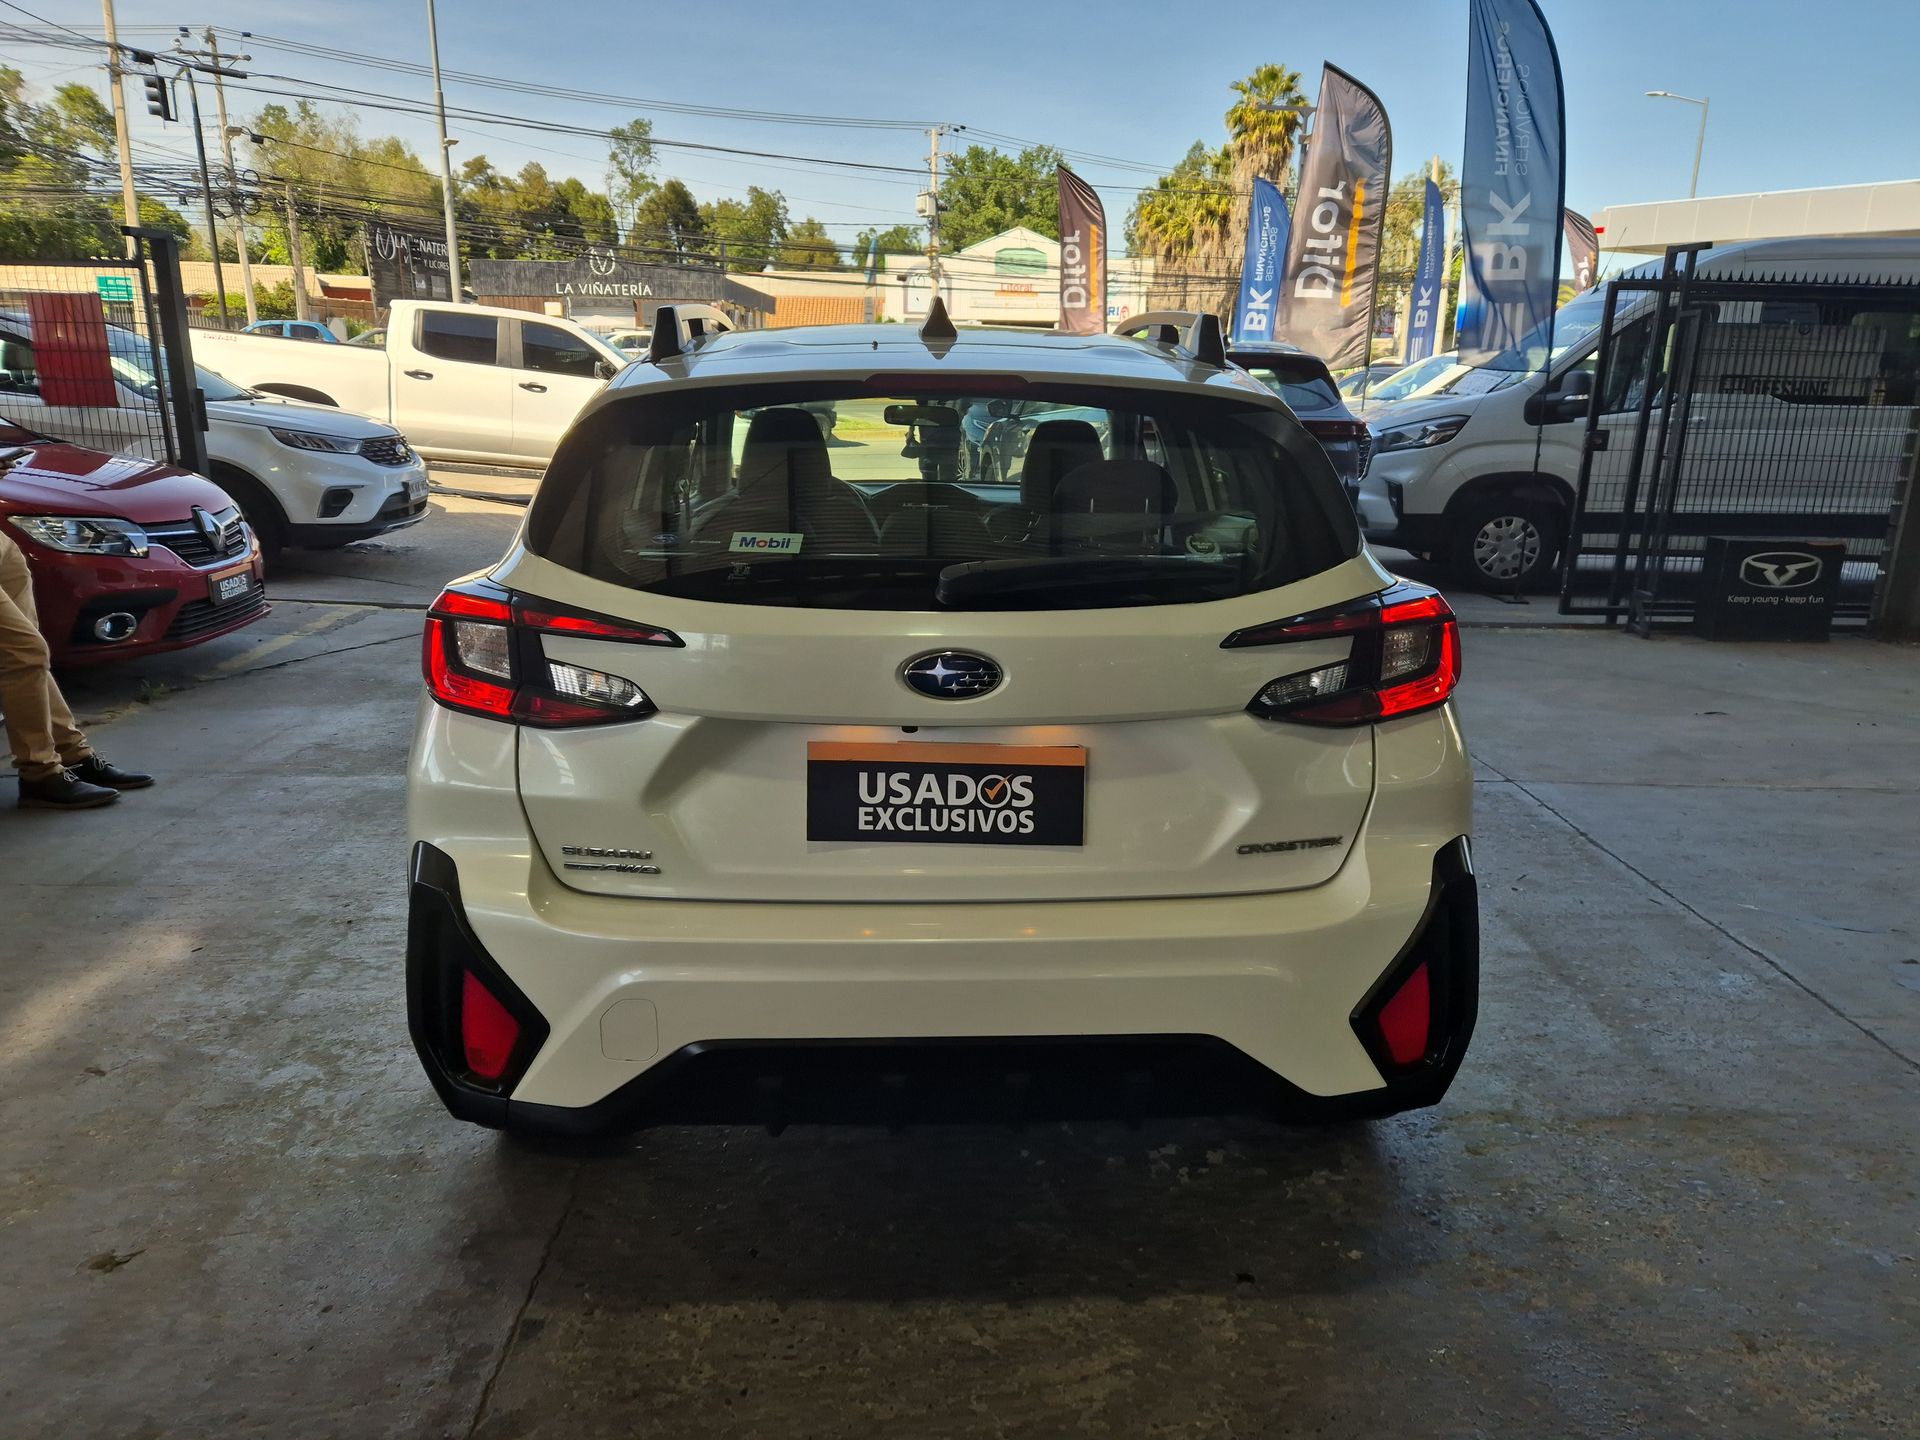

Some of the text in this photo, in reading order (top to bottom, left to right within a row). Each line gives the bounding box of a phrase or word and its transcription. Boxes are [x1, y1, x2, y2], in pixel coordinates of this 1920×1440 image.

[394, 235, 407, 249] LA
[555, 281, 653, 296] LA VIÑATERÍA
[739, 536, 791, 549] Mobil
[219, 574, 246, 592] USADOS
[221, 584, 248, 600] EXCLUSIVOS
[1727, 594, 1824, 605] Keep young keep fun
[858, 771, 1034, 809] USADOS
[858, 807, 1035, 835] EXCLUSIVOS
[562, 845, 653, 860] SUBARU
[1236, 834, 1343, 856] CROSSTREK
